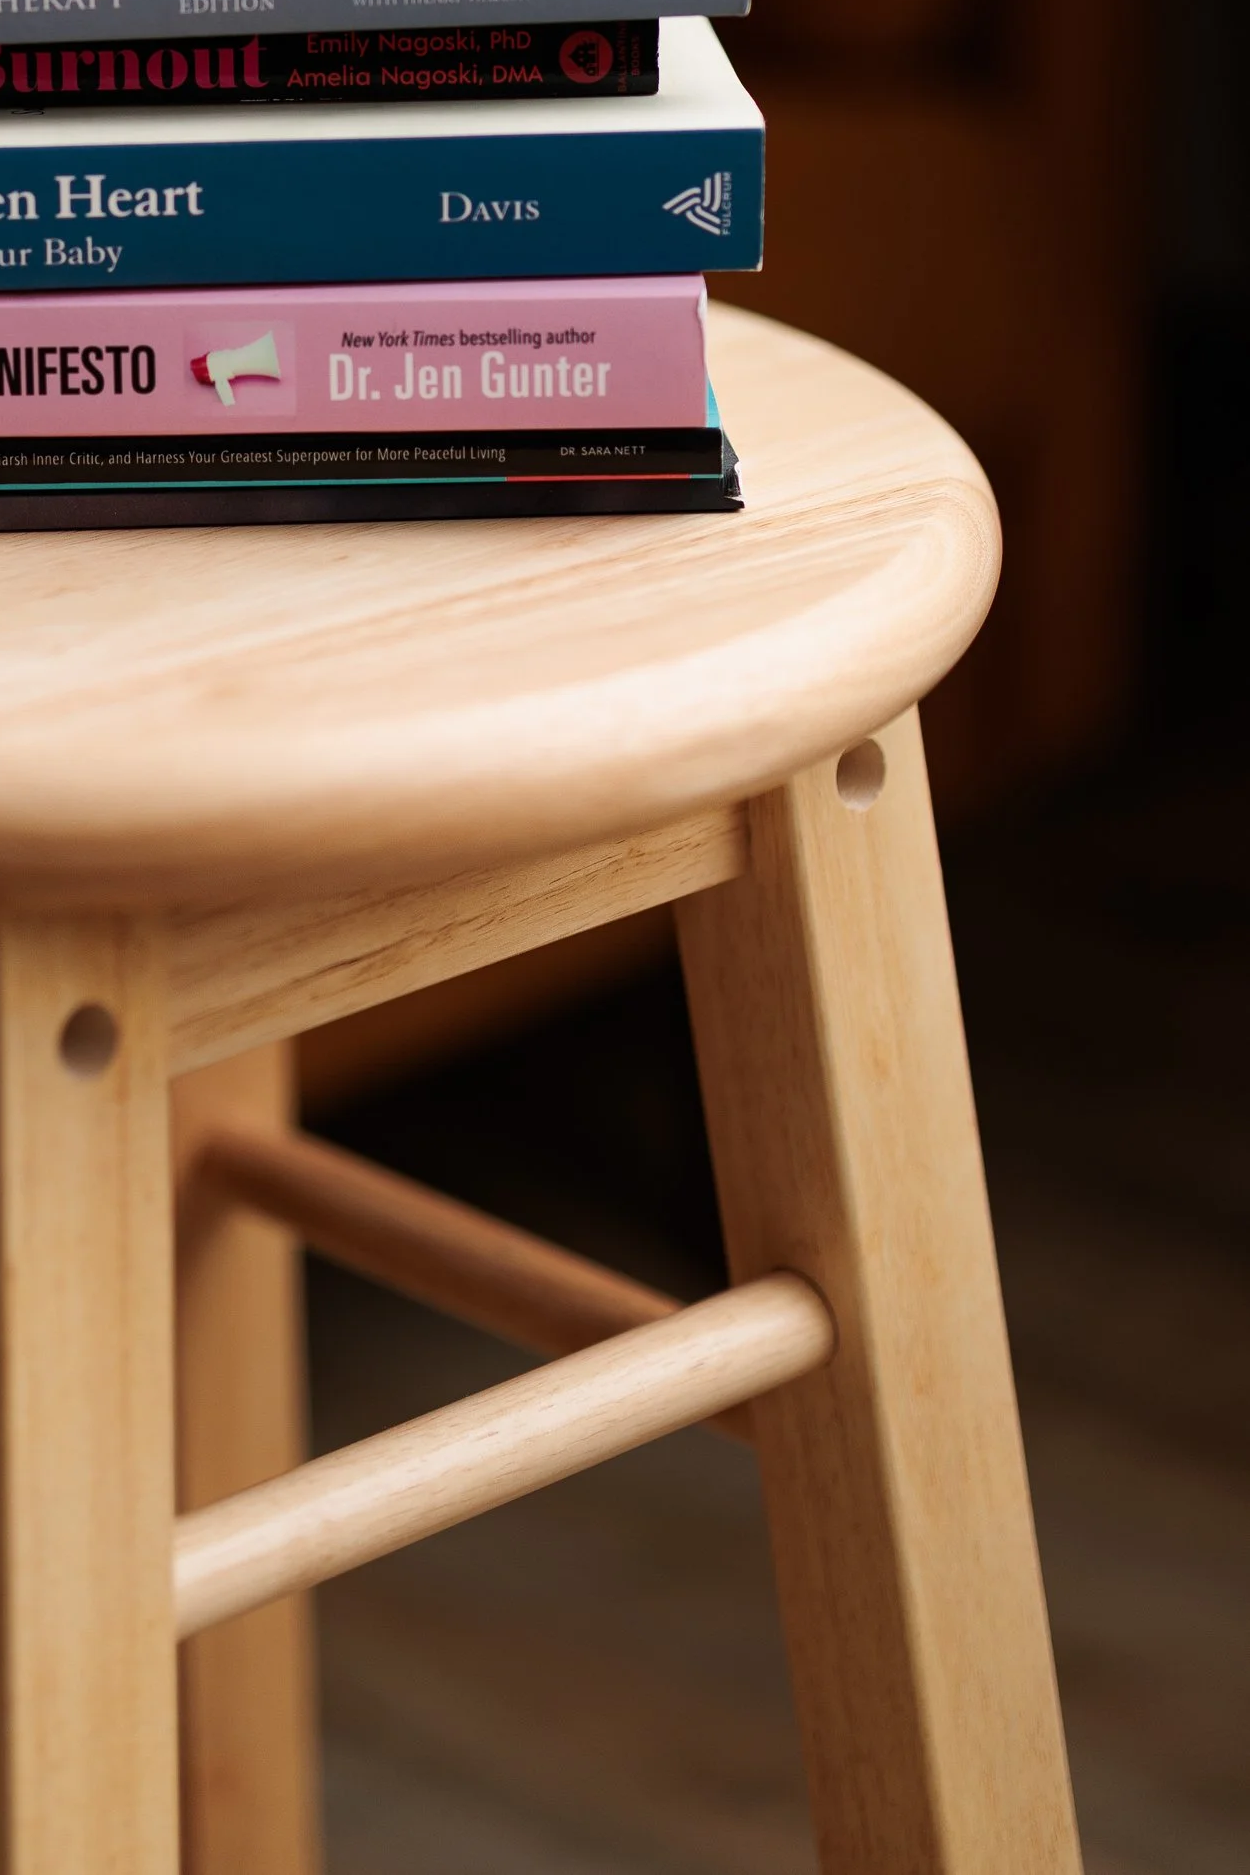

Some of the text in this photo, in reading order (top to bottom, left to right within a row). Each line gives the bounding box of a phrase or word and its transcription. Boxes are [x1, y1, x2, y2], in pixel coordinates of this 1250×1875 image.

[307, 28, 532, 57] Emily Nagoski, PhD
[287, 62, 545, 90] Amelia Nagoski, DMA
[54, 173, 205, 219] Heart
[721, 171, 732, 236] FULCRUM
[44, 235, 123, 273] Baby
[341, 327, 596, 349] New York Times bestselling author
[329, 350, 612, 402] Dr. Jen Gunter
[32, 452, 65, 467] Inner
[69, 451, 104, 467] Critic,
[108, 451, 132, 466] and
[135, 450, 185, 466] Harness
[188, 450, 216, 464] Your
[220, 449, 273, 464] Greatest
[276, 448, 352, 466] Superpower
[355, 447, 373, 462] for
[377, 447, 410, 462] More
[414, 446, 466, 461] Peaceful
[470, 445, 506, 463] Living
[581, 446, 611, 457] SARA
[614, 445, 646, 456] NETT
